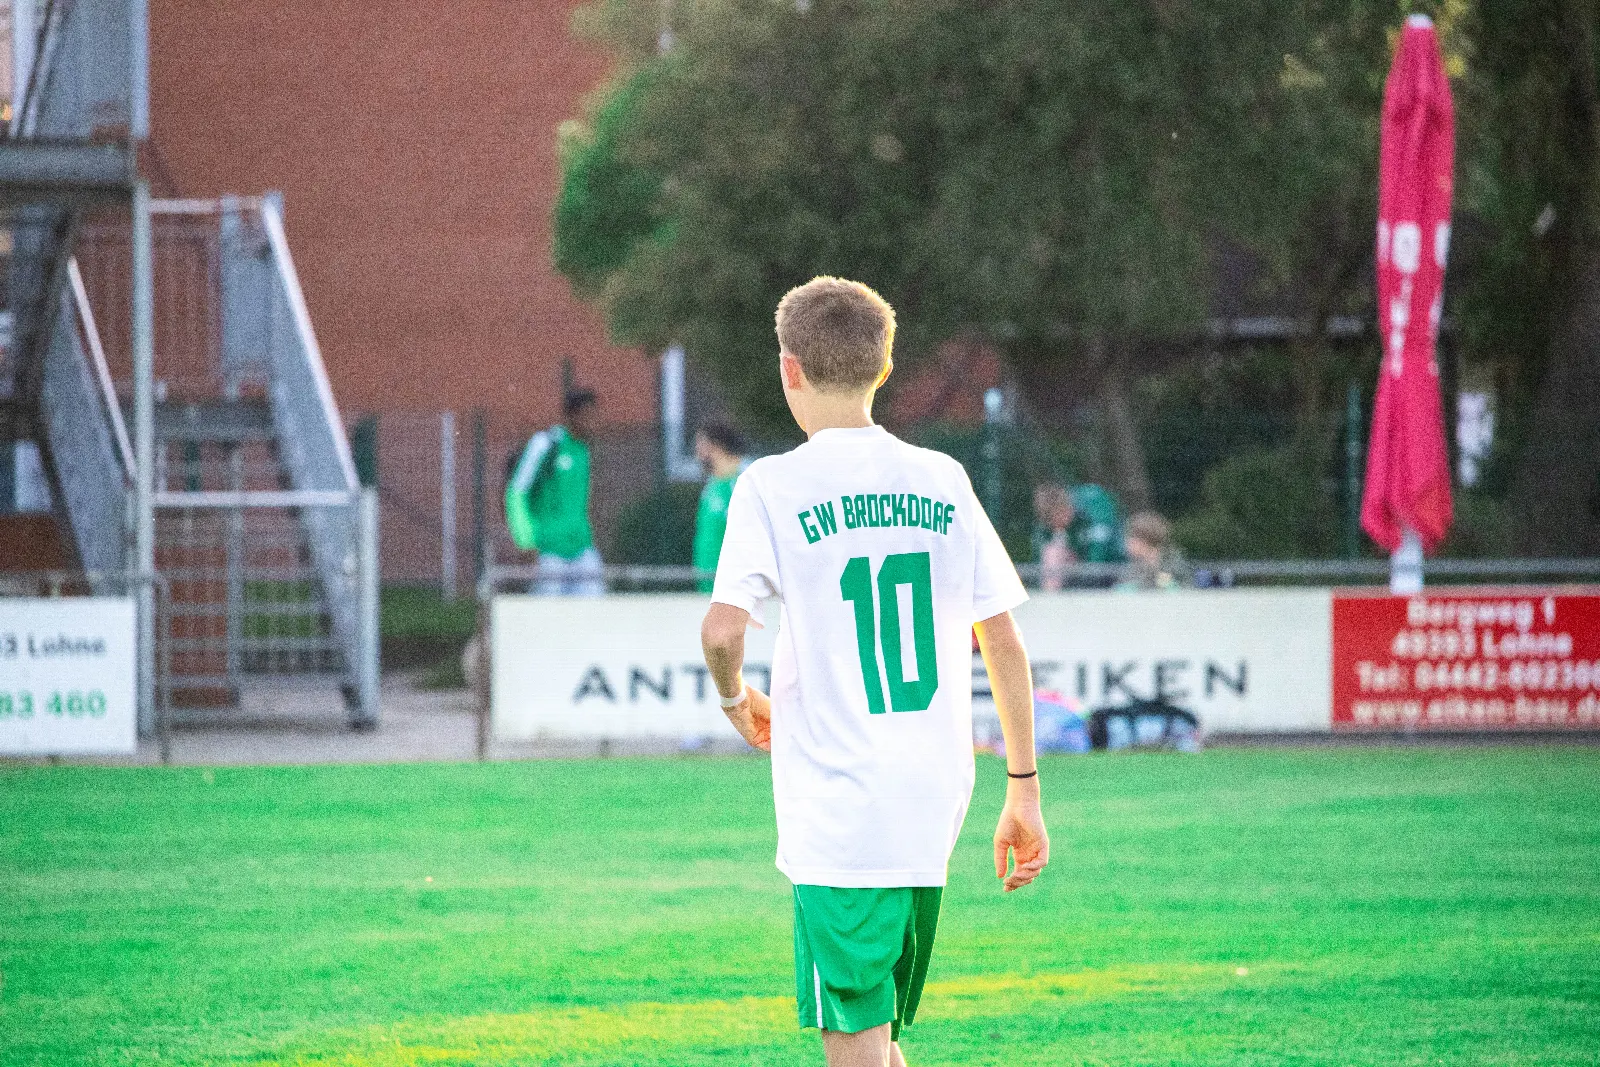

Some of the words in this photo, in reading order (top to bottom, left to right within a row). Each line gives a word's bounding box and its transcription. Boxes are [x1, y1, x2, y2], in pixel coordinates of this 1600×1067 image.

[798, 500, 838, 545] GW
[841, 493, 956, 536] BROCKDORF
[27, 632, 106, 658] Lohne
[839, 551, 939, 715] 10
[1482, 631, 1573, 659] Lohne
